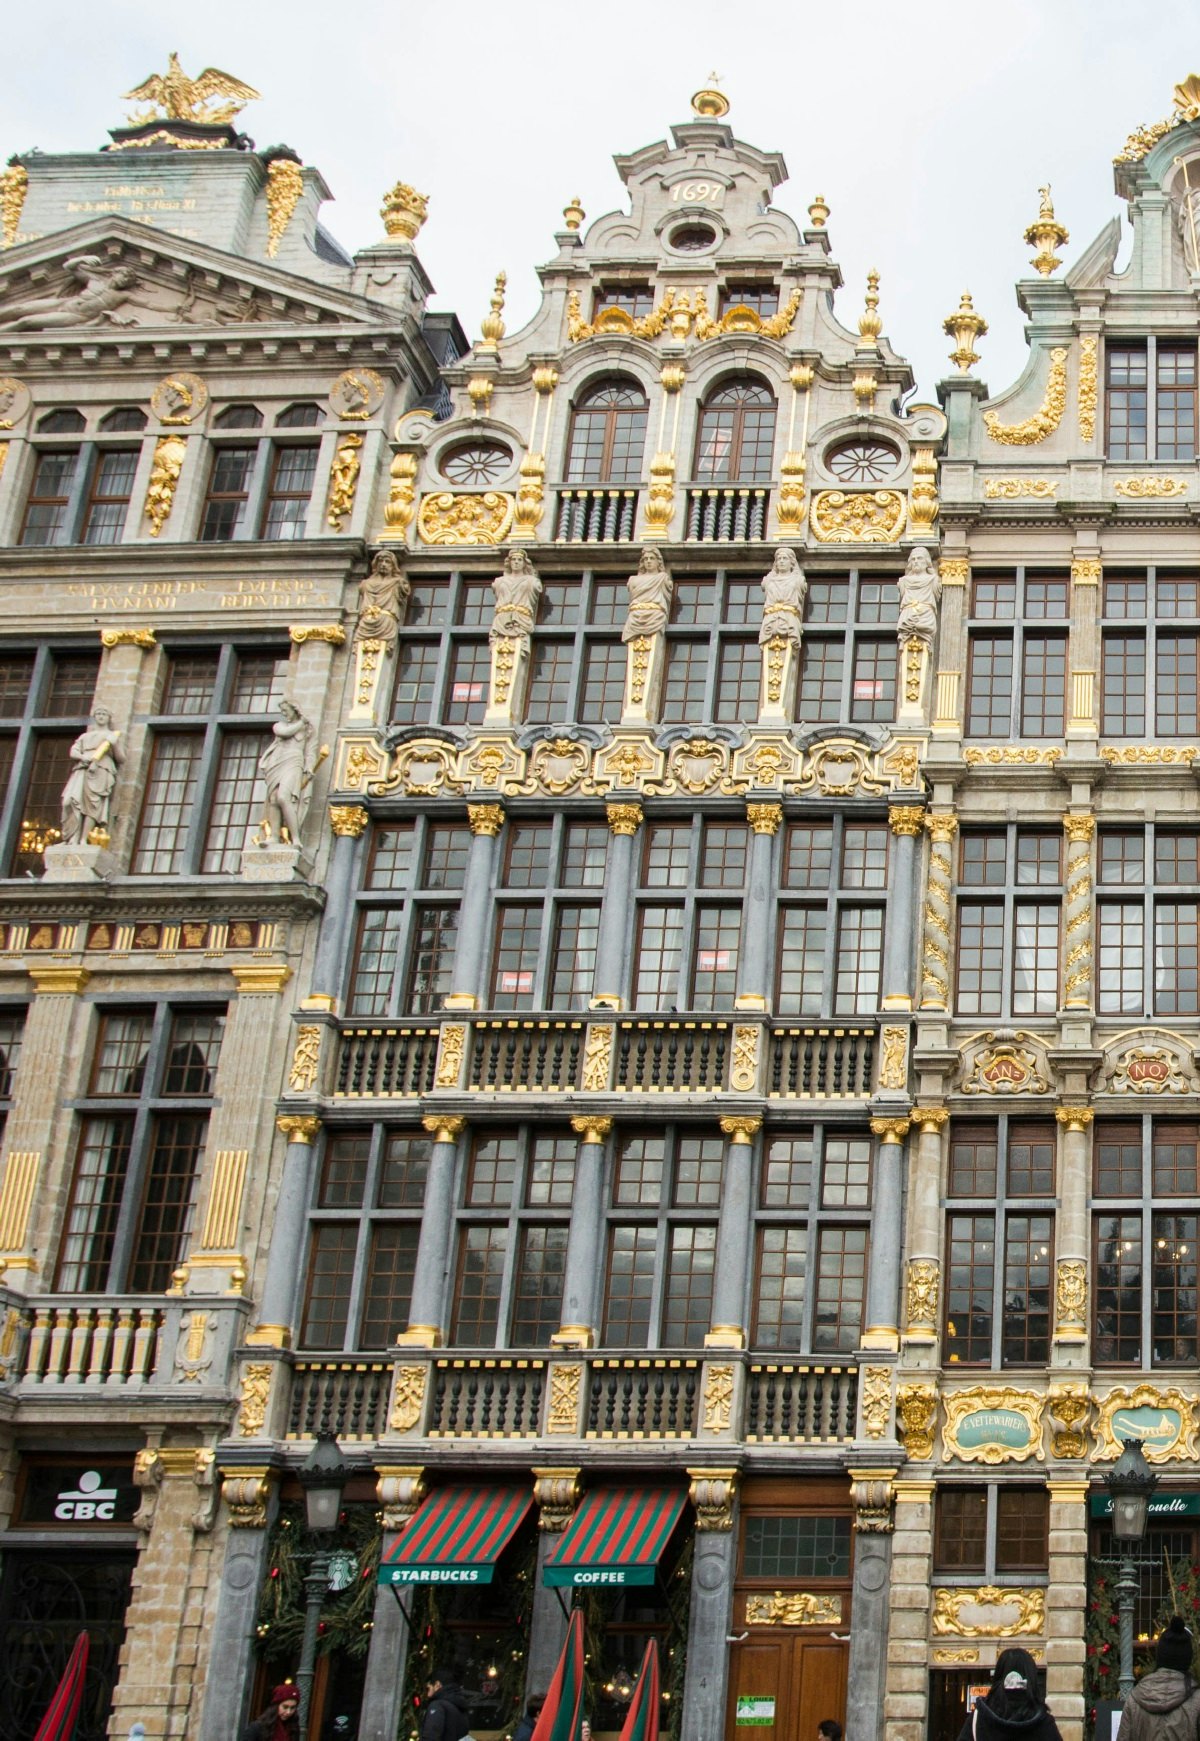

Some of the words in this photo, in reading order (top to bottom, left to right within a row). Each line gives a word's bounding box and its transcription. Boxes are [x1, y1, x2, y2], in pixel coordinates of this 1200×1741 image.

[672, 183, 722, 201] 1697
[1135, 1064, 1163, 1078] NO.
[54, 1502, 116, 1520] CBC
[391, 1570, 478, 1581] STARBUCKS
[573, 1572, 625, 1583] COFFEE
